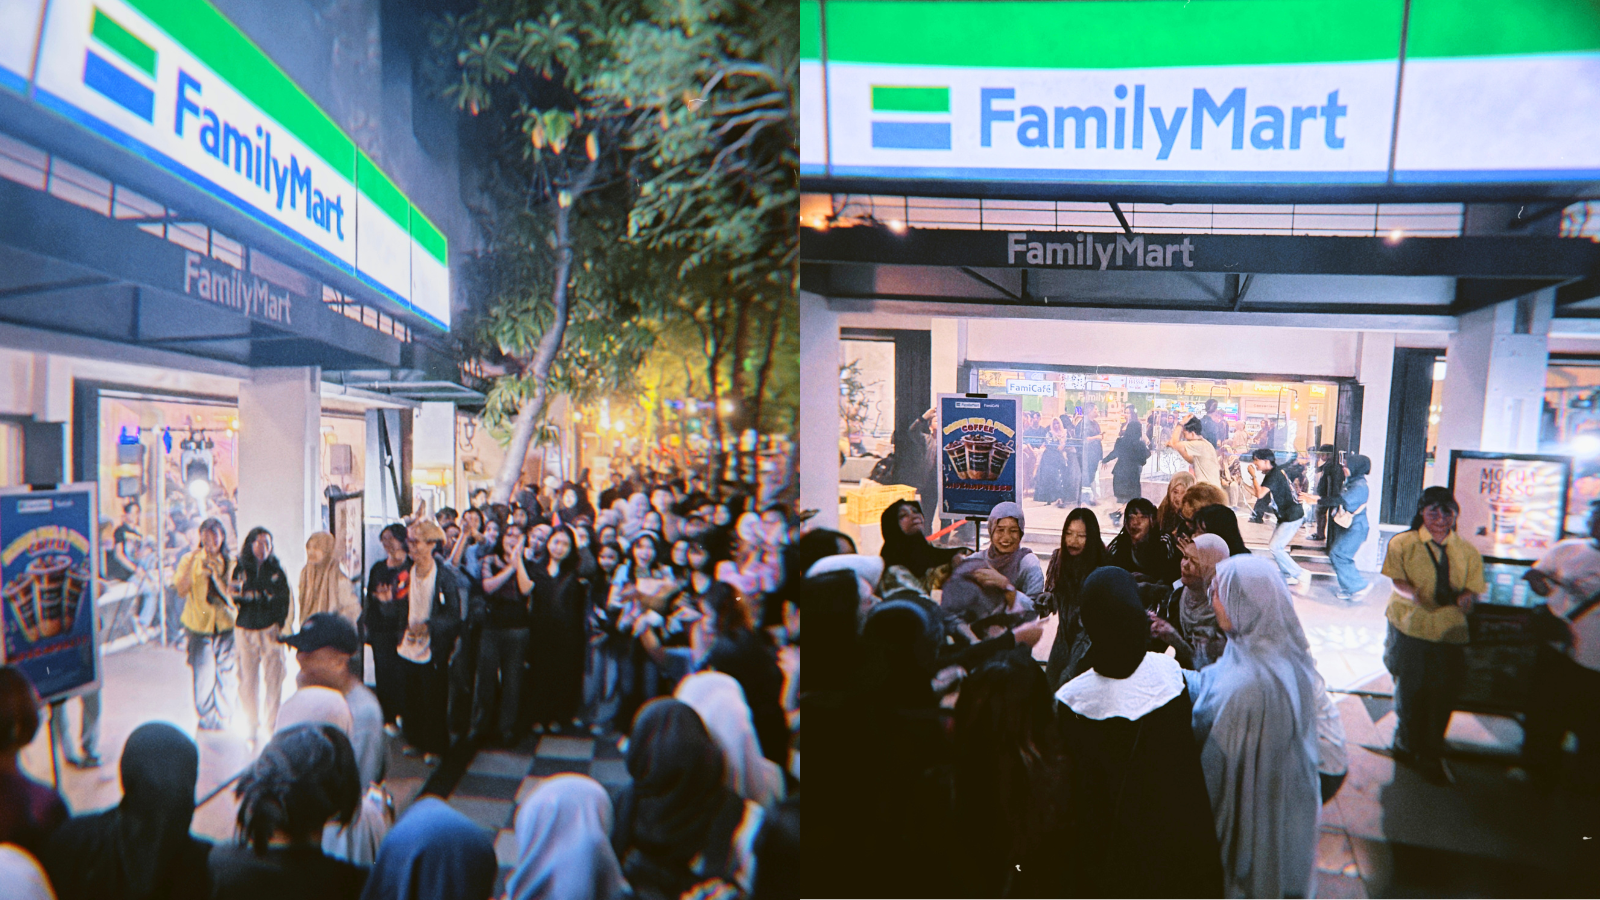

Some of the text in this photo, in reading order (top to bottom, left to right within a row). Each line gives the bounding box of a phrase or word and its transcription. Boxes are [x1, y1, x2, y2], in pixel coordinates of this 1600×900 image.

[980, 84, 1347, 160] FamilyMart
[174, 68, 345, 240] FamilyMart
[1007, 233, 1194, 270] FamilyMart
[184, 252, 292, 324] FamilyMart
[1009, 383, 1051, 393] FamiCafé
[961, 424, 995, 434] COFFEE
